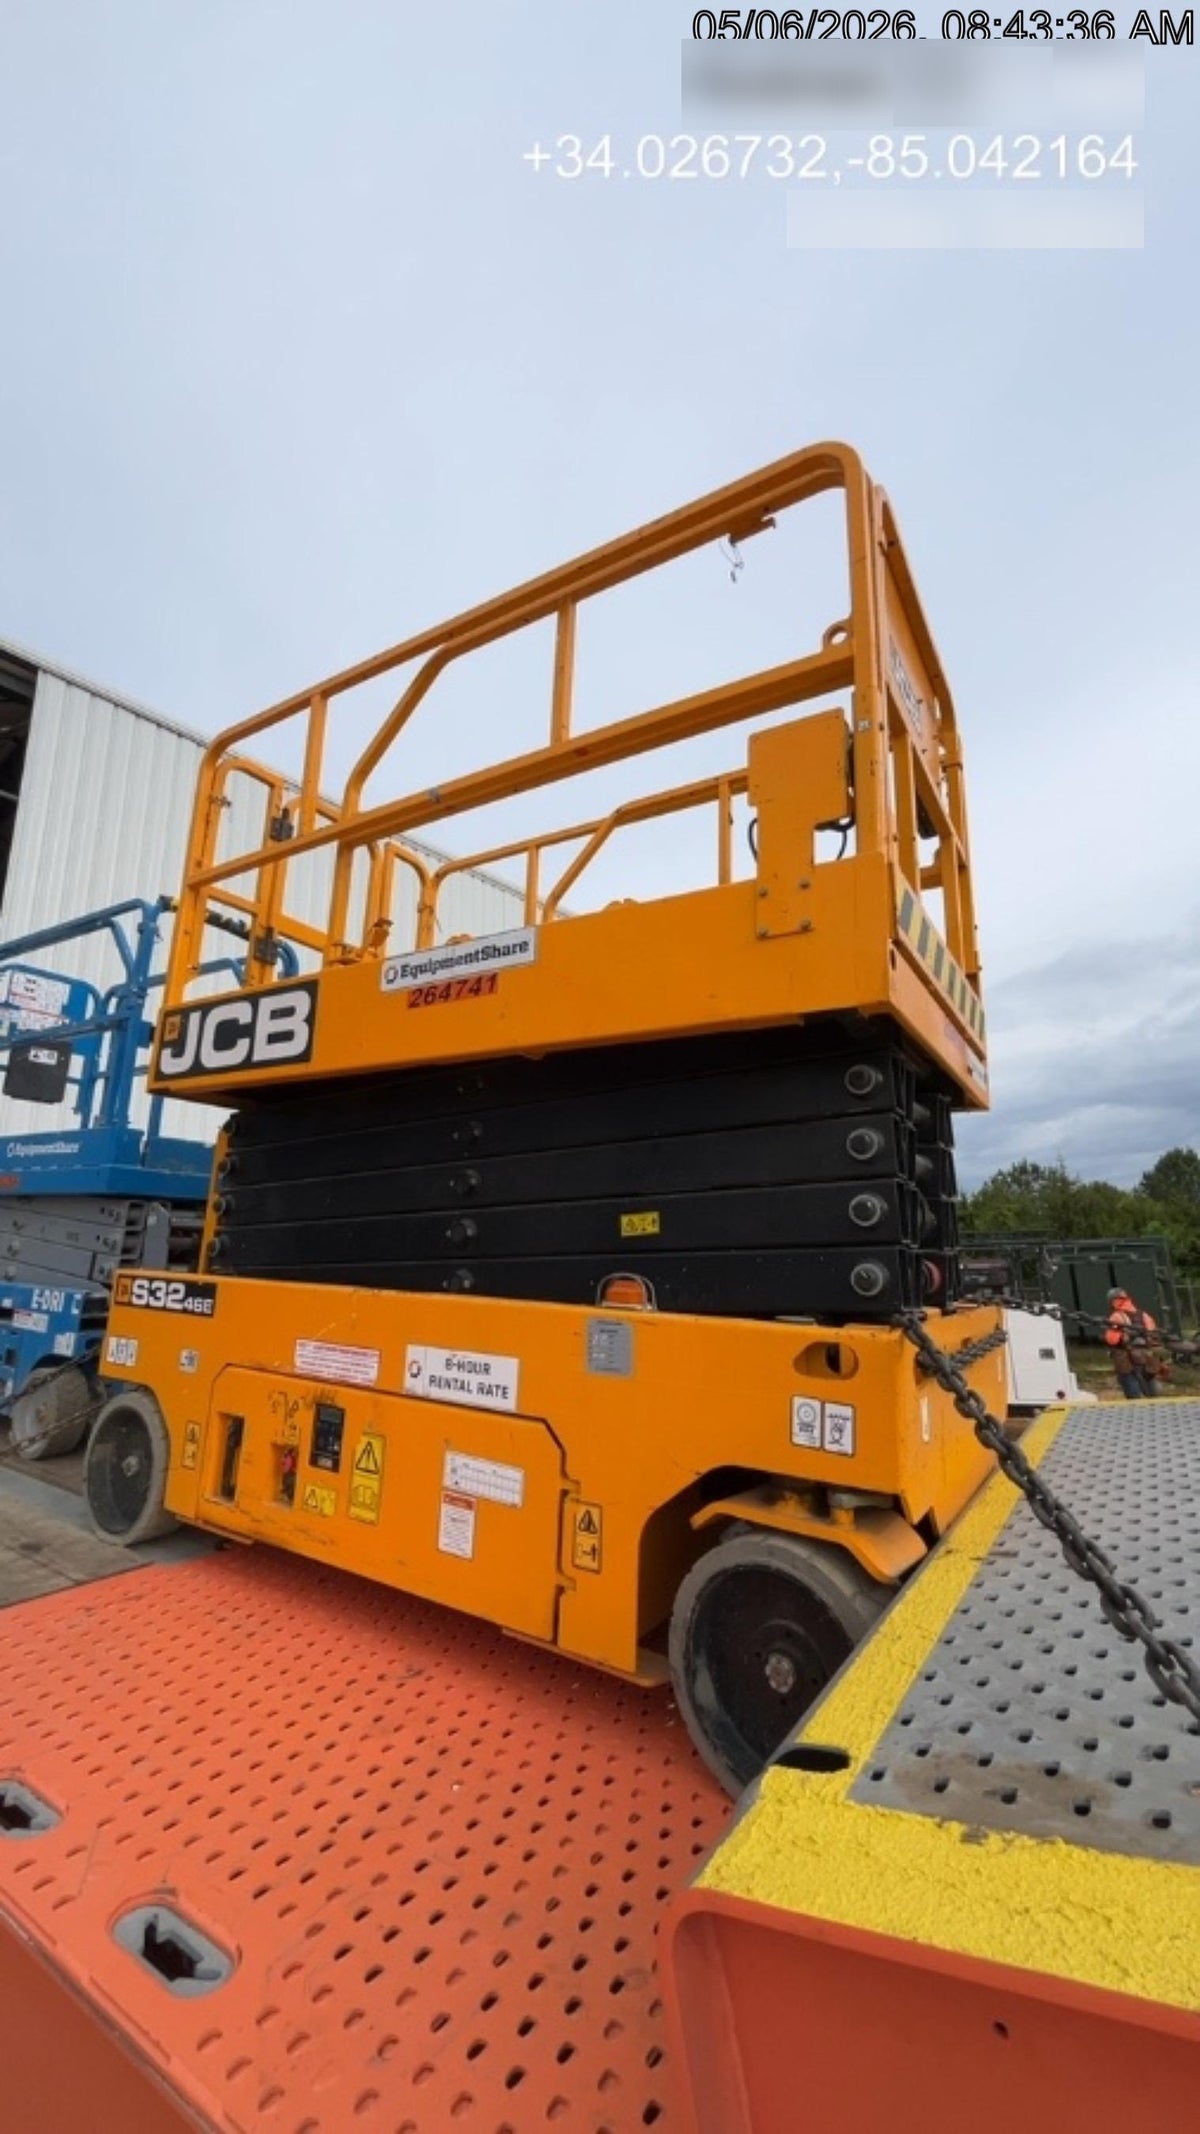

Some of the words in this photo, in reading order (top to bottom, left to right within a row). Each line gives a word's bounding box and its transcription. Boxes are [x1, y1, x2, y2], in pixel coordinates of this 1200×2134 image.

[400, 940, 530, 980] EquipmentShare
[407, 972, 499, 1009] 264741
[160, 989, 312, 1075] JCB
[428, 1374, 473, 1394] RENTAL
[476, 1380, 509, 1400] RATE
